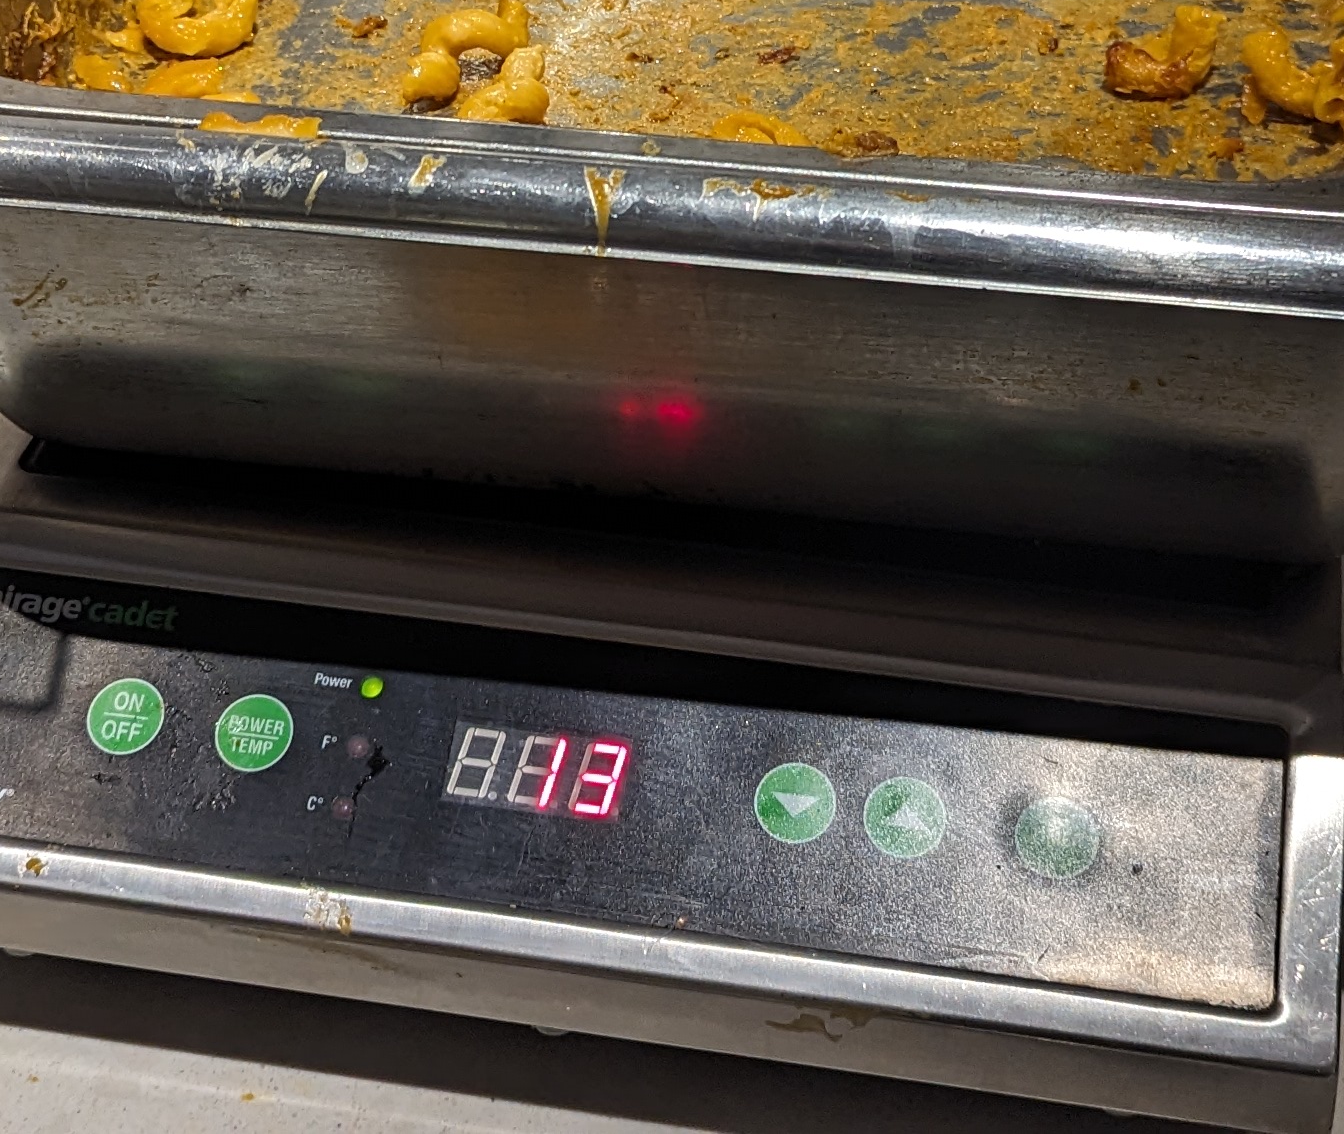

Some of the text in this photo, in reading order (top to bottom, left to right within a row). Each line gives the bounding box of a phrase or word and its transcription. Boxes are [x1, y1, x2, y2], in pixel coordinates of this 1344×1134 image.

[87, 600, 180, 631] cadet
[314, 672, 353, 689] Power
[115, 691, 146, 713] ON
[101, 720, 143, 743] OFF
[228, 715, 284, 736] POWER
[230, 736, 274, 756] TEMP
[536, 736, 628, 816] 13
